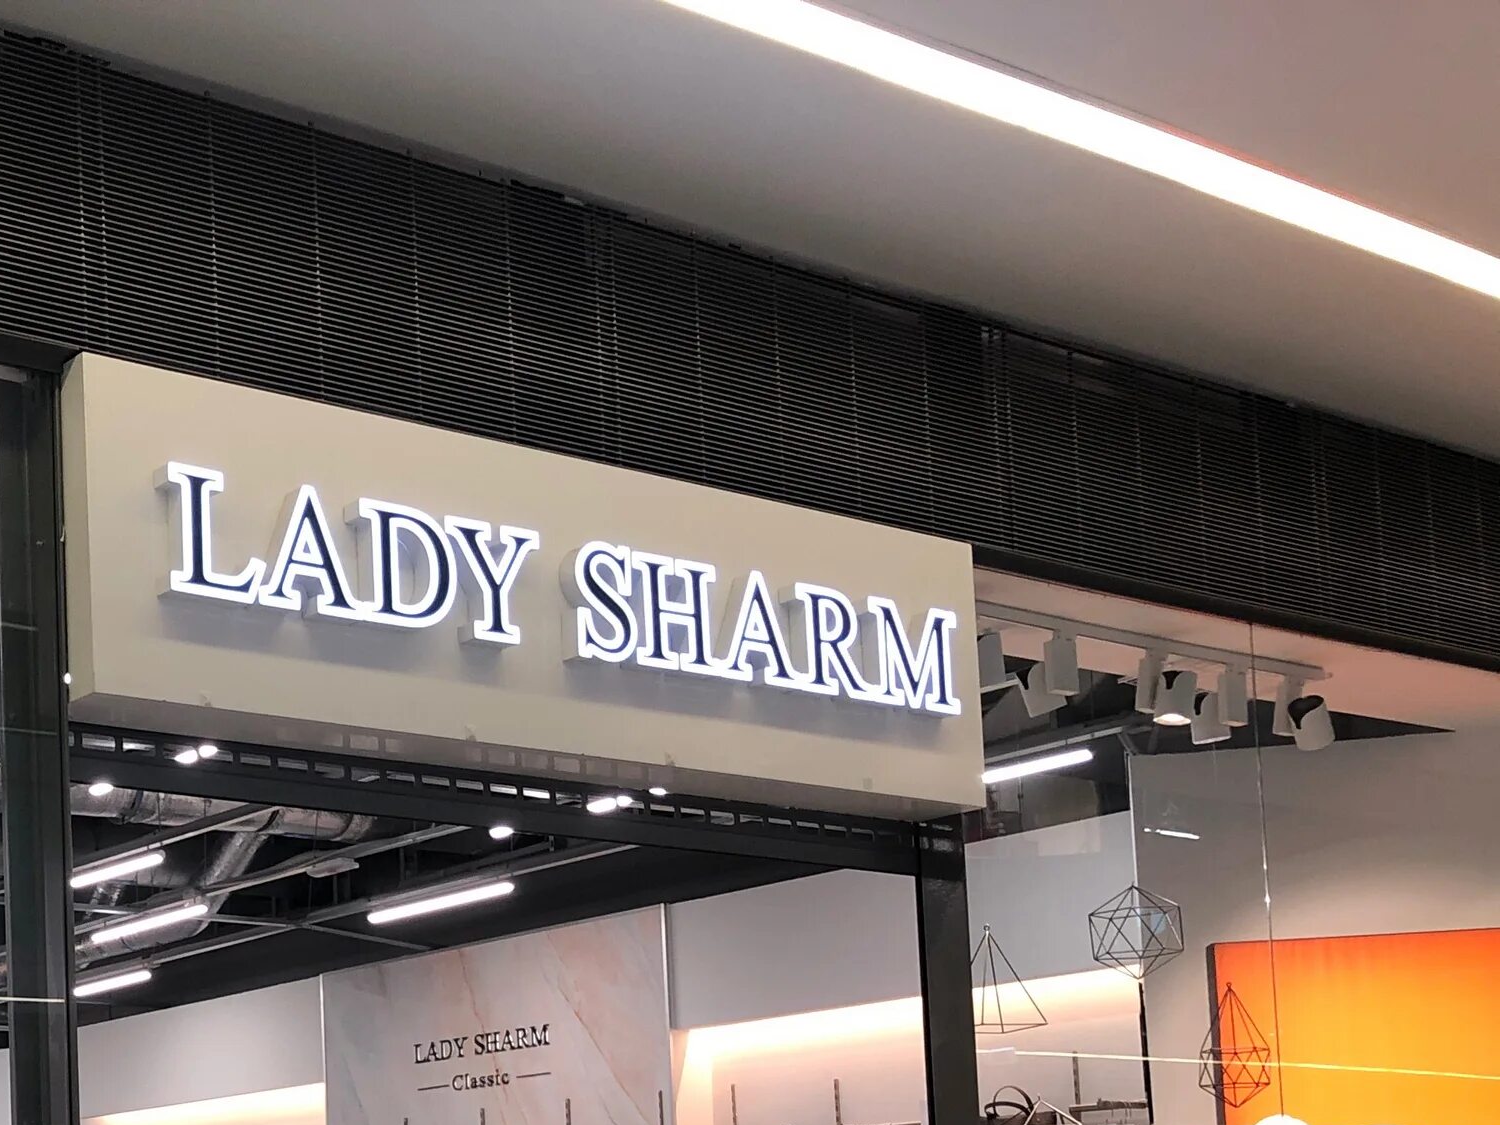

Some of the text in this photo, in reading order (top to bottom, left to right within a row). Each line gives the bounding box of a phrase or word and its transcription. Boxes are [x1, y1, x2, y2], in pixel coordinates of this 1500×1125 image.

[162, 460, 963, 718] LADY SHARM
[413, 1023, 551, 1064] LADY SHARM
[451, 1069, 511, 1092] Classic
